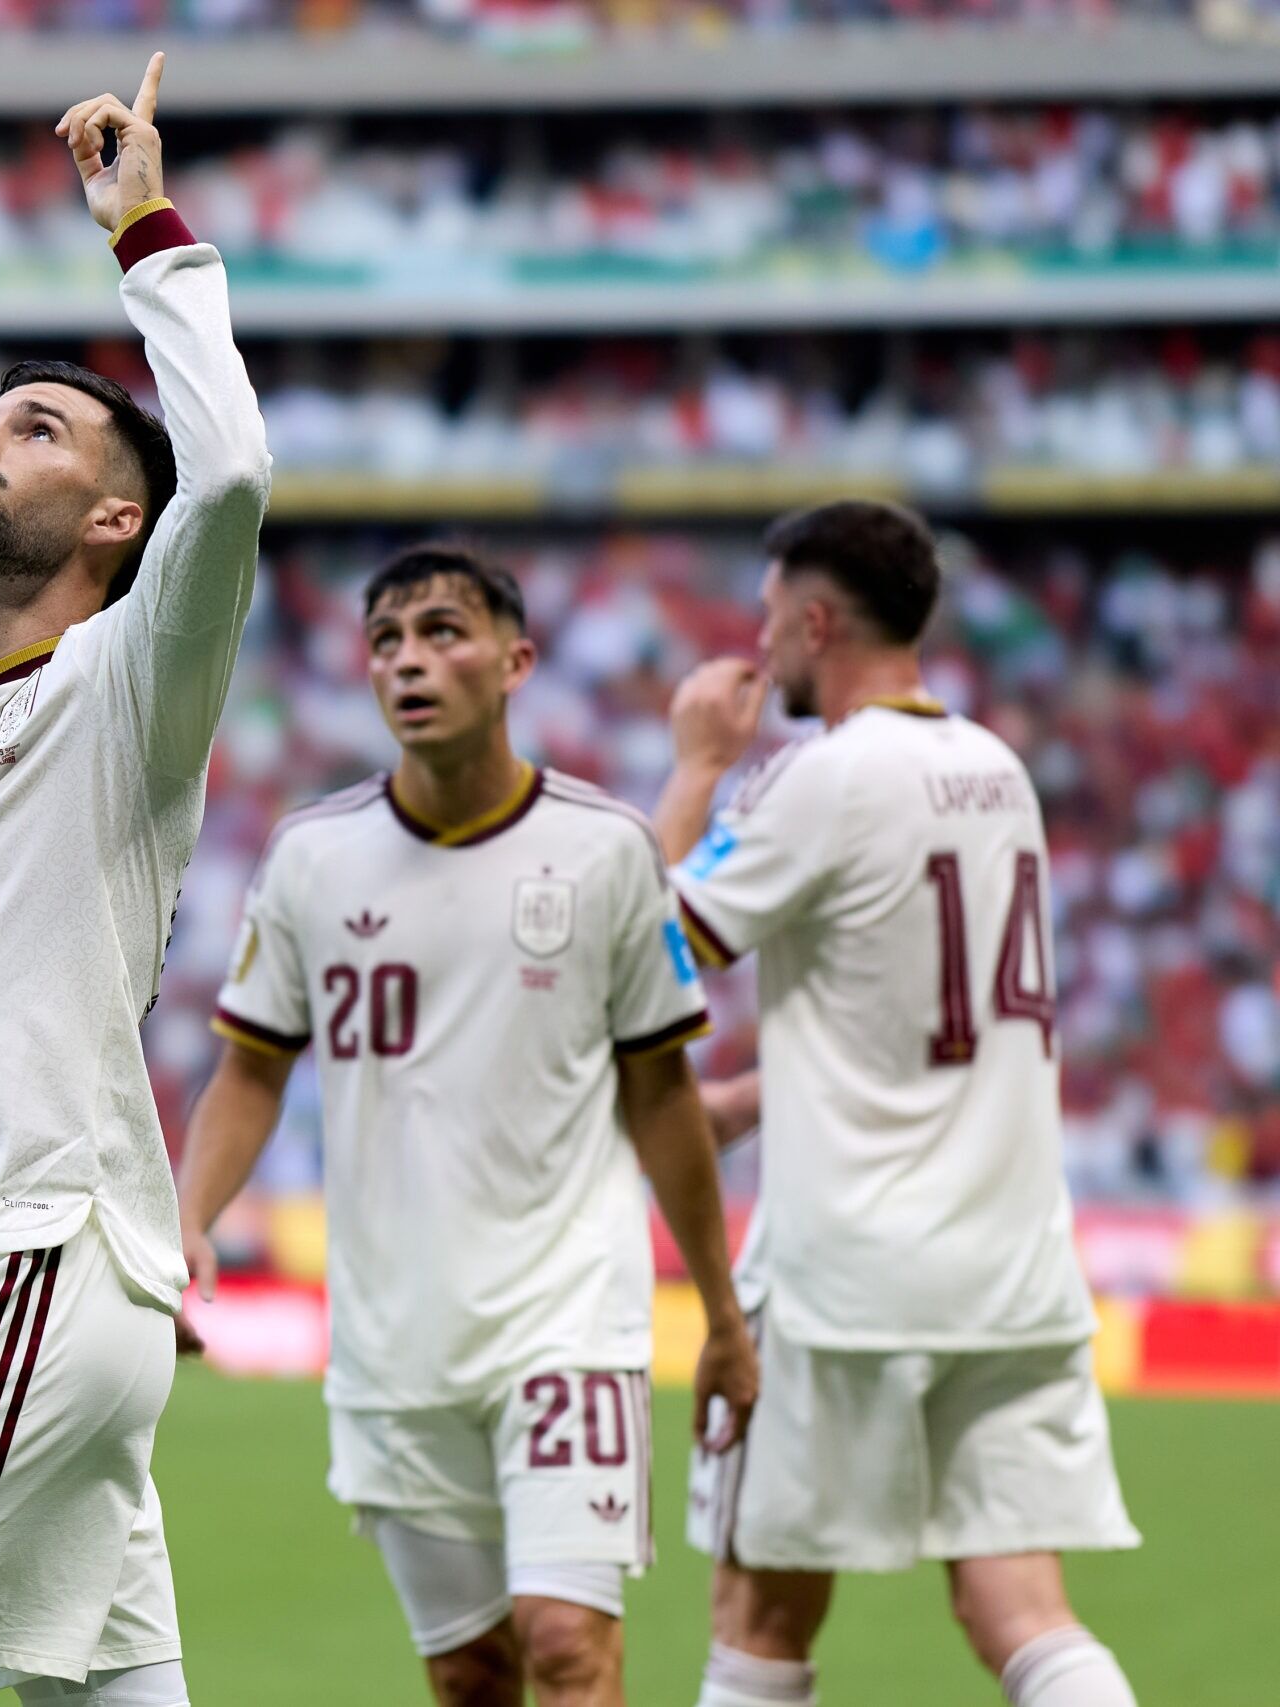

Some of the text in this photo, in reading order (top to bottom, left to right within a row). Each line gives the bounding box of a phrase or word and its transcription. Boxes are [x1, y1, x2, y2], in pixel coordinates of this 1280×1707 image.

[927, 850, 1057, 1068] 14
[324, 963, 418, 1058] 20
[523, 1371, 628, 1467] 20
